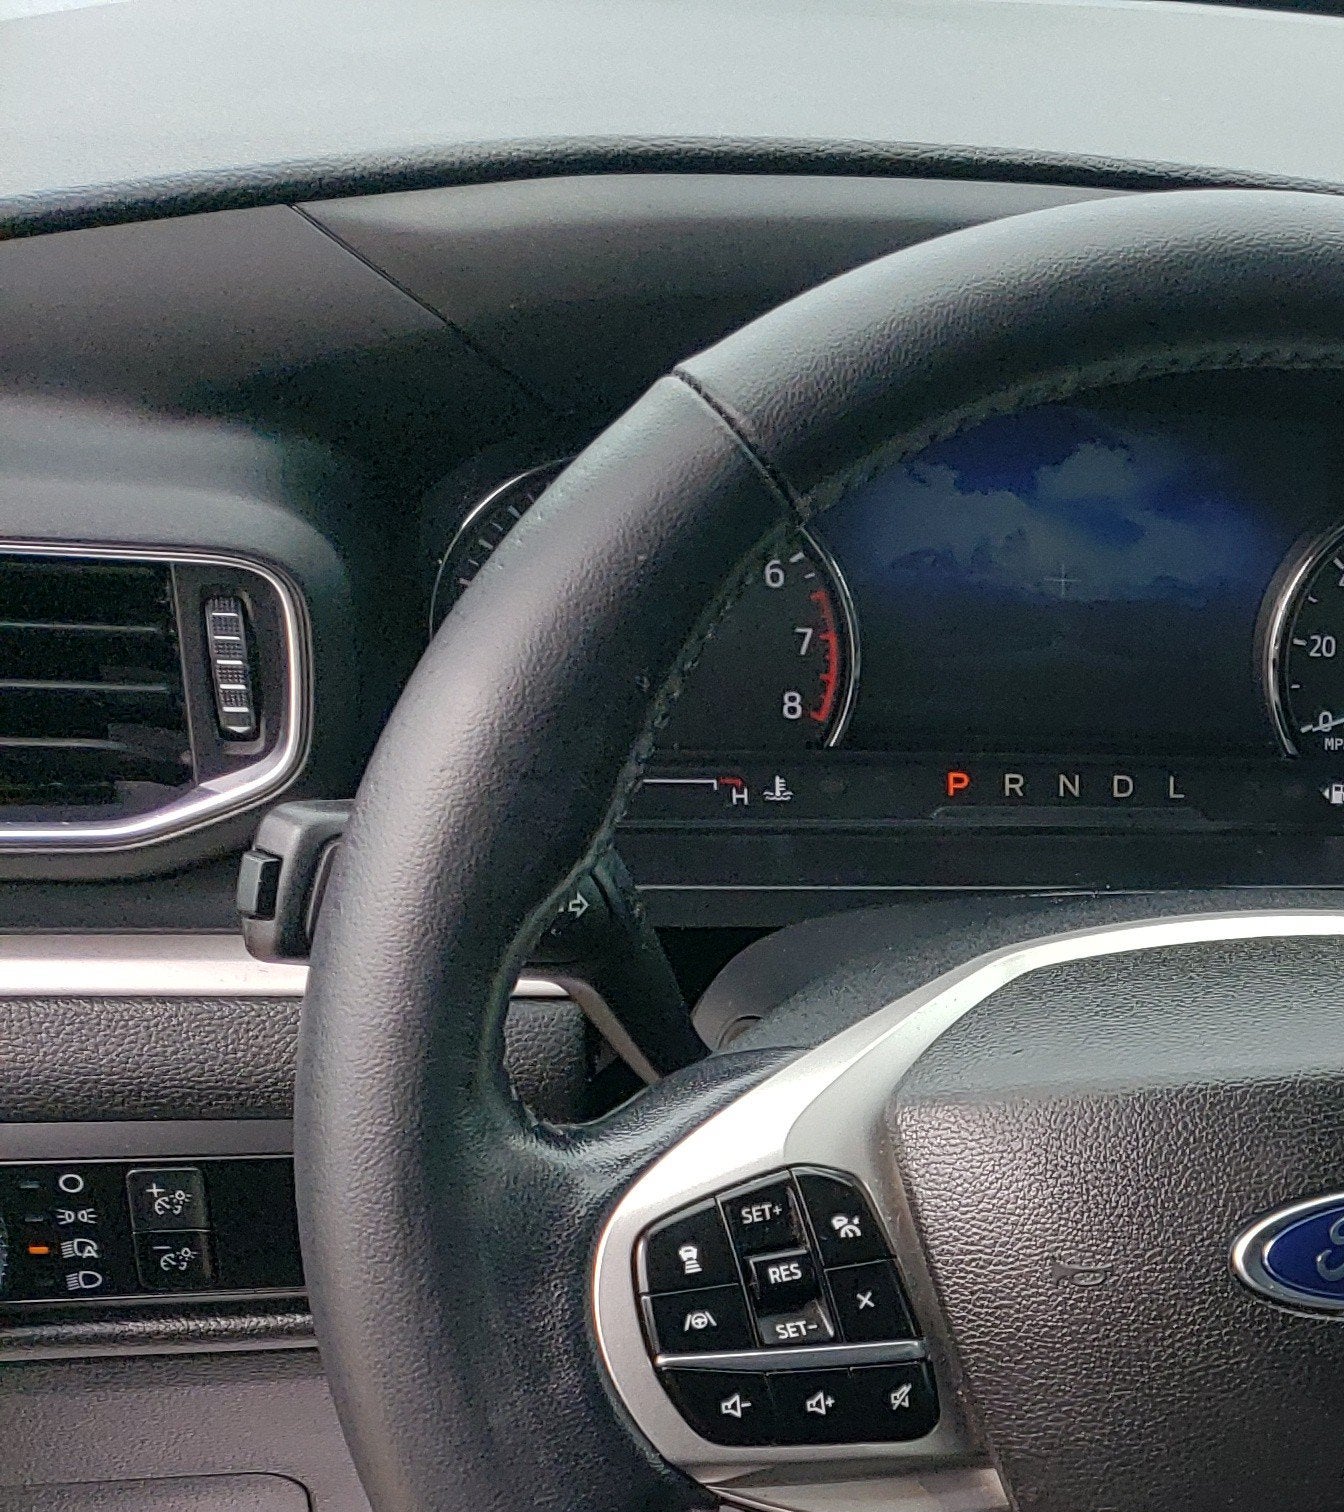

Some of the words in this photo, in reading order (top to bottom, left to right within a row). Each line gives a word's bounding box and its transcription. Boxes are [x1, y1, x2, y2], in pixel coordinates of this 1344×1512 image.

[763, 561, 785, 588] 6
[793, 627, 814, 656] 7
[1308, 636, 1337, 658] 20
[781, 692, 802, 719] 8
[1318, 712, 1334, 732] 0
[731, 787, 748, 806] H
[947, 772, 970, 796] P
[1003, 773, 1024, 796] R
[1059, 774, 1080, 797] N
[1112, 775, 1134, 797] D
[1169, 776, 1185, 798] L
[768, 1262, 803, 1284] RES
